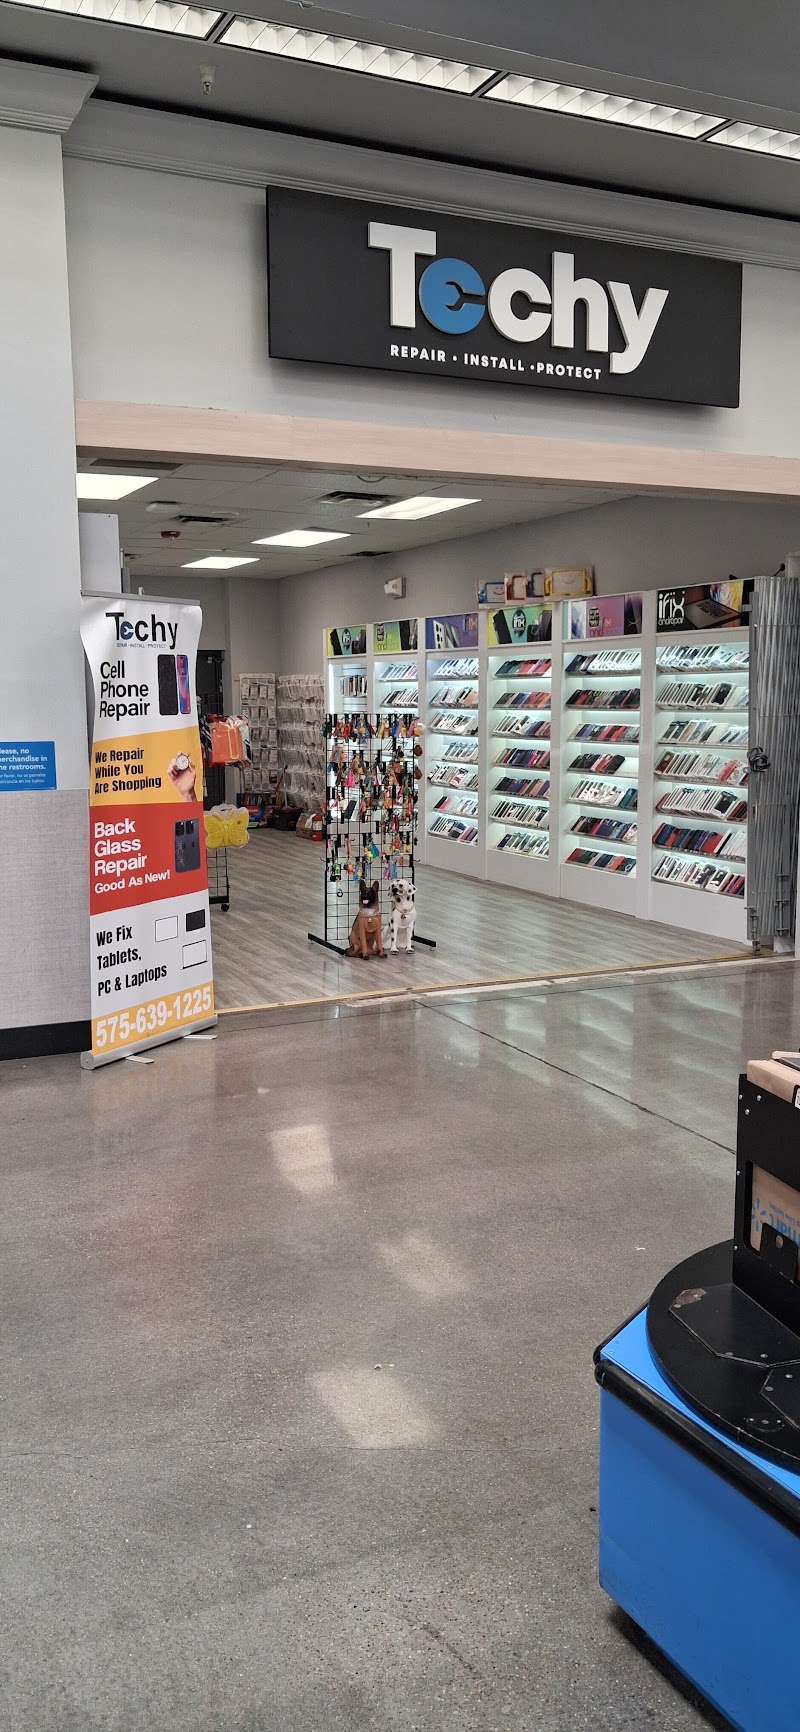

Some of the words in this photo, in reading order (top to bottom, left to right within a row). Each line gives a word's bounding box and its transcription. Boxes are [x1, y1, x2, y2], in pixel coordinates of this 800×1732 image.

[368, 221, 669, 374] Techy
[389, 344, 447, 363] REPAIR
[463, 353, 526, 372] INSTALL
[105, 612, 178, 650] Techy
[100, 660, 125, 679] Cell
[100, 680, 149, 699] Phone
[99, 698, 151, 721] Repair
[0, 747, 19, 755] lease,
[95, 751, 107, 764] We
[110, 747, 145, 762] Repair
[95, 764, 121, 779] While
[124, 764, 144, 775] You
[95, 782, 109, 795] Are
[112, 776, 162, 792] Shopping
[94, 818, 136, 838] Back
[94, 839, 142, 857] Glass
[94, 852, 148, 877] Repair
[94, 878, 125, 894] Good
[128, 876, 143, 888] As
[144, 869, 171, 889] New!
[96, 930, 113, 947] We
[116, 925, 133, 942] Fix
[97, 948, 142, 971] Tablets,
[98, 979, 111, 997] PC
[114, 976, 122, 991] &
[125, 965, 168, 988] Laptops
[95, 985, 212, 1047] 575-639-1225
